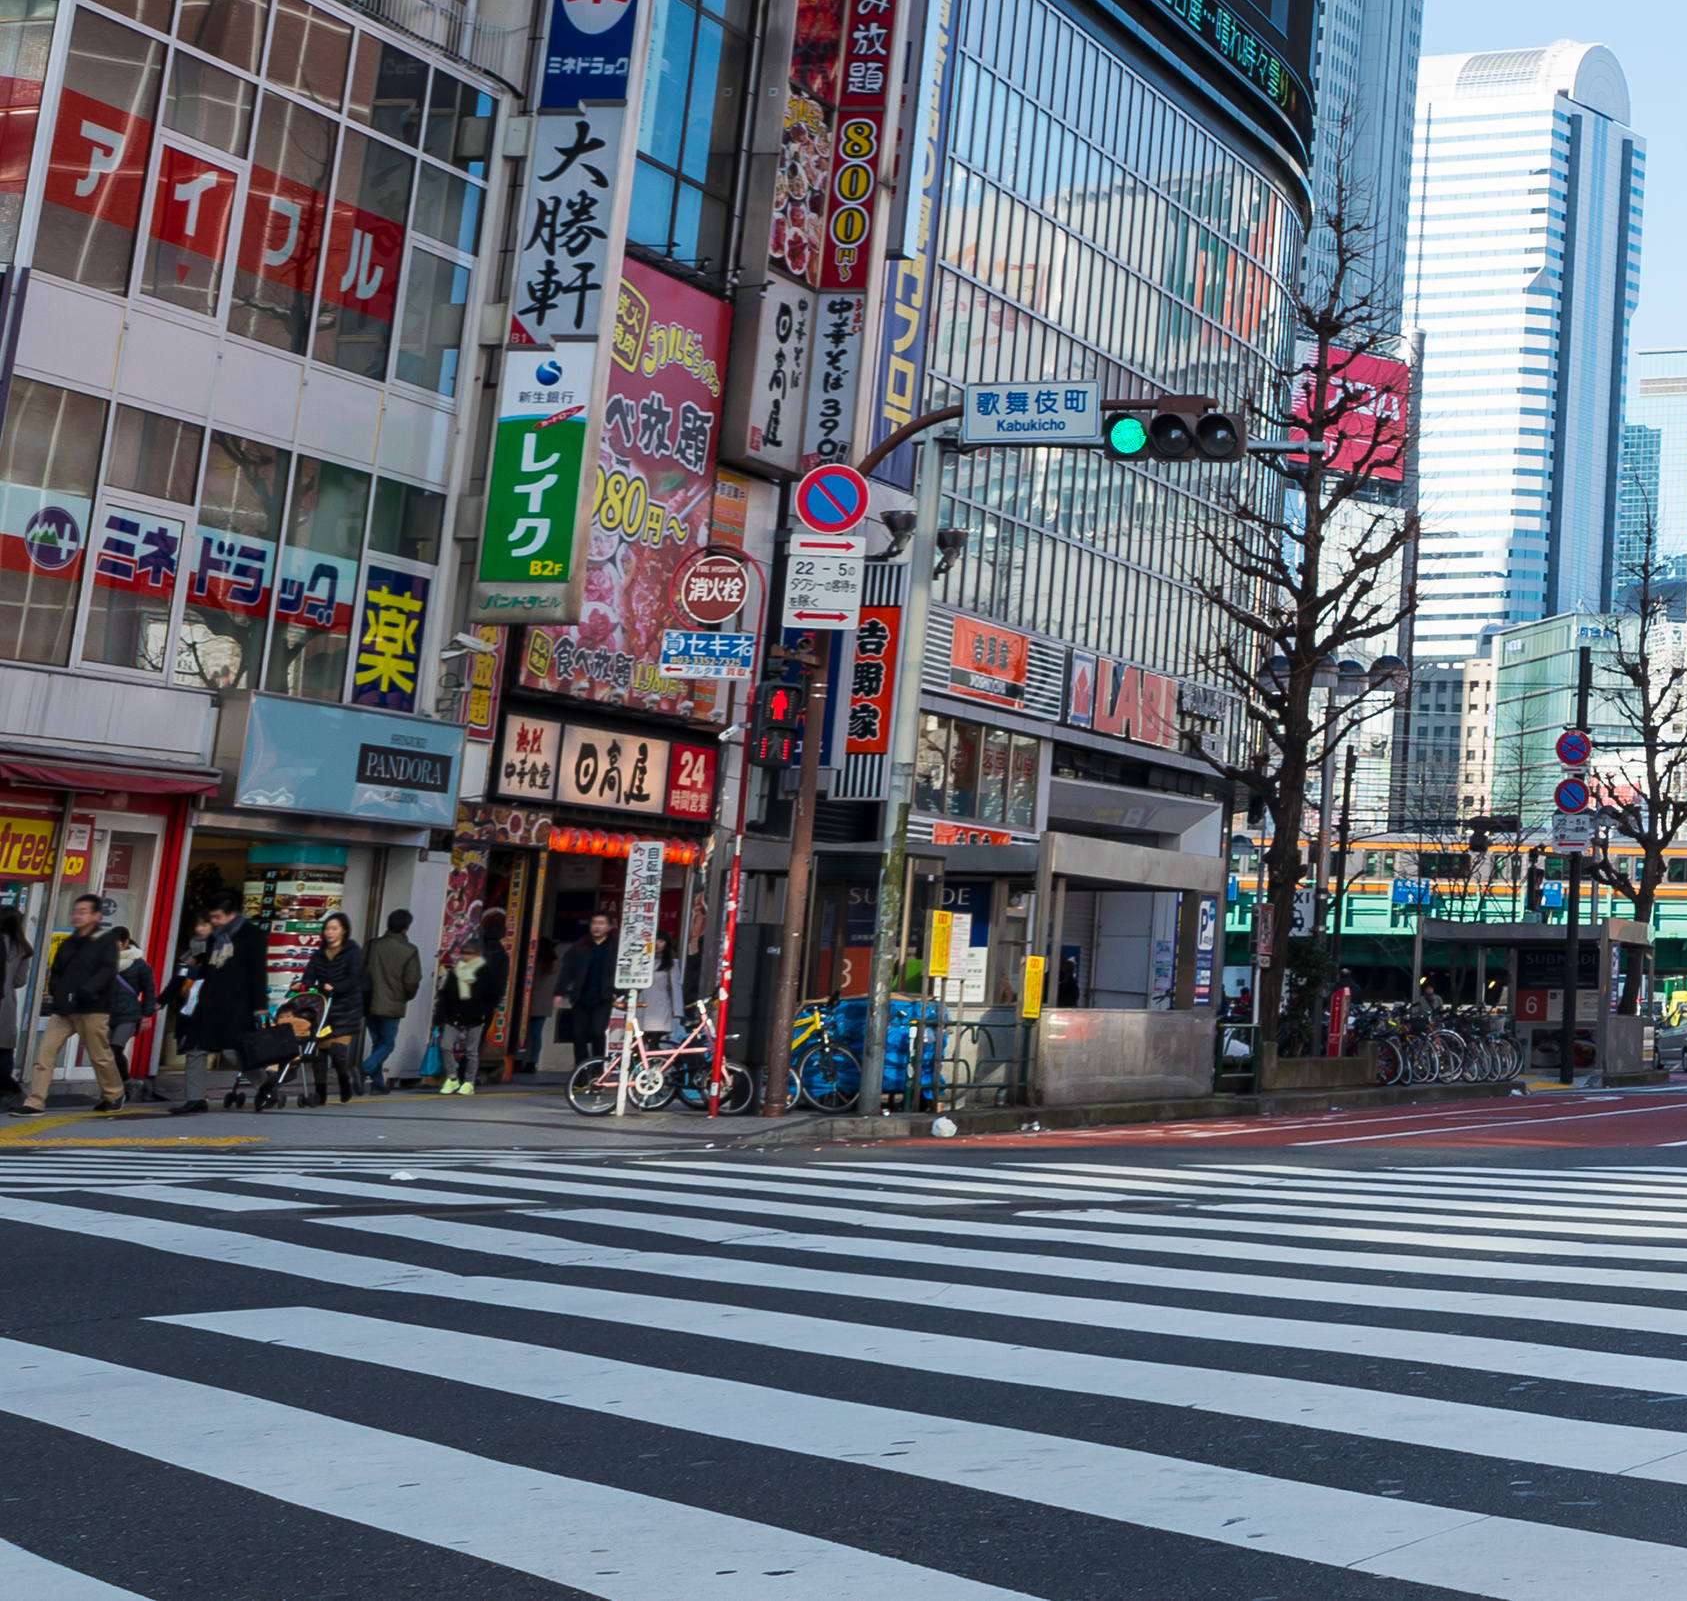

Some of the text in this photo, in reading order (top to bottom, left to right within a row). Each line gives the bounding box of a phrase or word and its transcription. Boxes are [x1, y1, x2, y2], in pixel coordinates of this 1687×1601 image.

[547, 55, 630, 77] ミネドラッグ
[74, 119, 384, 300] アイフル
[517, 120, 609, 329] 大勝軒
[518, 390, 573, 404] 新生銀行
[976, 389, 1089, 417] 歌舞伎町
[997, 418, 1066, 433] Kabukicho
[508, 433, 562, 557] レイク
[95, 515, 339, 627] ミネドラッグ
[689, 577, 743, 603] 消火栓
[355, 585, 425, 695] 薬
[846, 619, 889, 740] 吉野家
[1099, 659, 1180, 747] LABI
[364, 752, 443, 786] PANDORA
[504, 756, 551, 790] 中華食堂
[575, 742, 651, 805] 日高屋
[679, 751, 706, 788] 24
[671, 789, 708, 813] 時間営業
